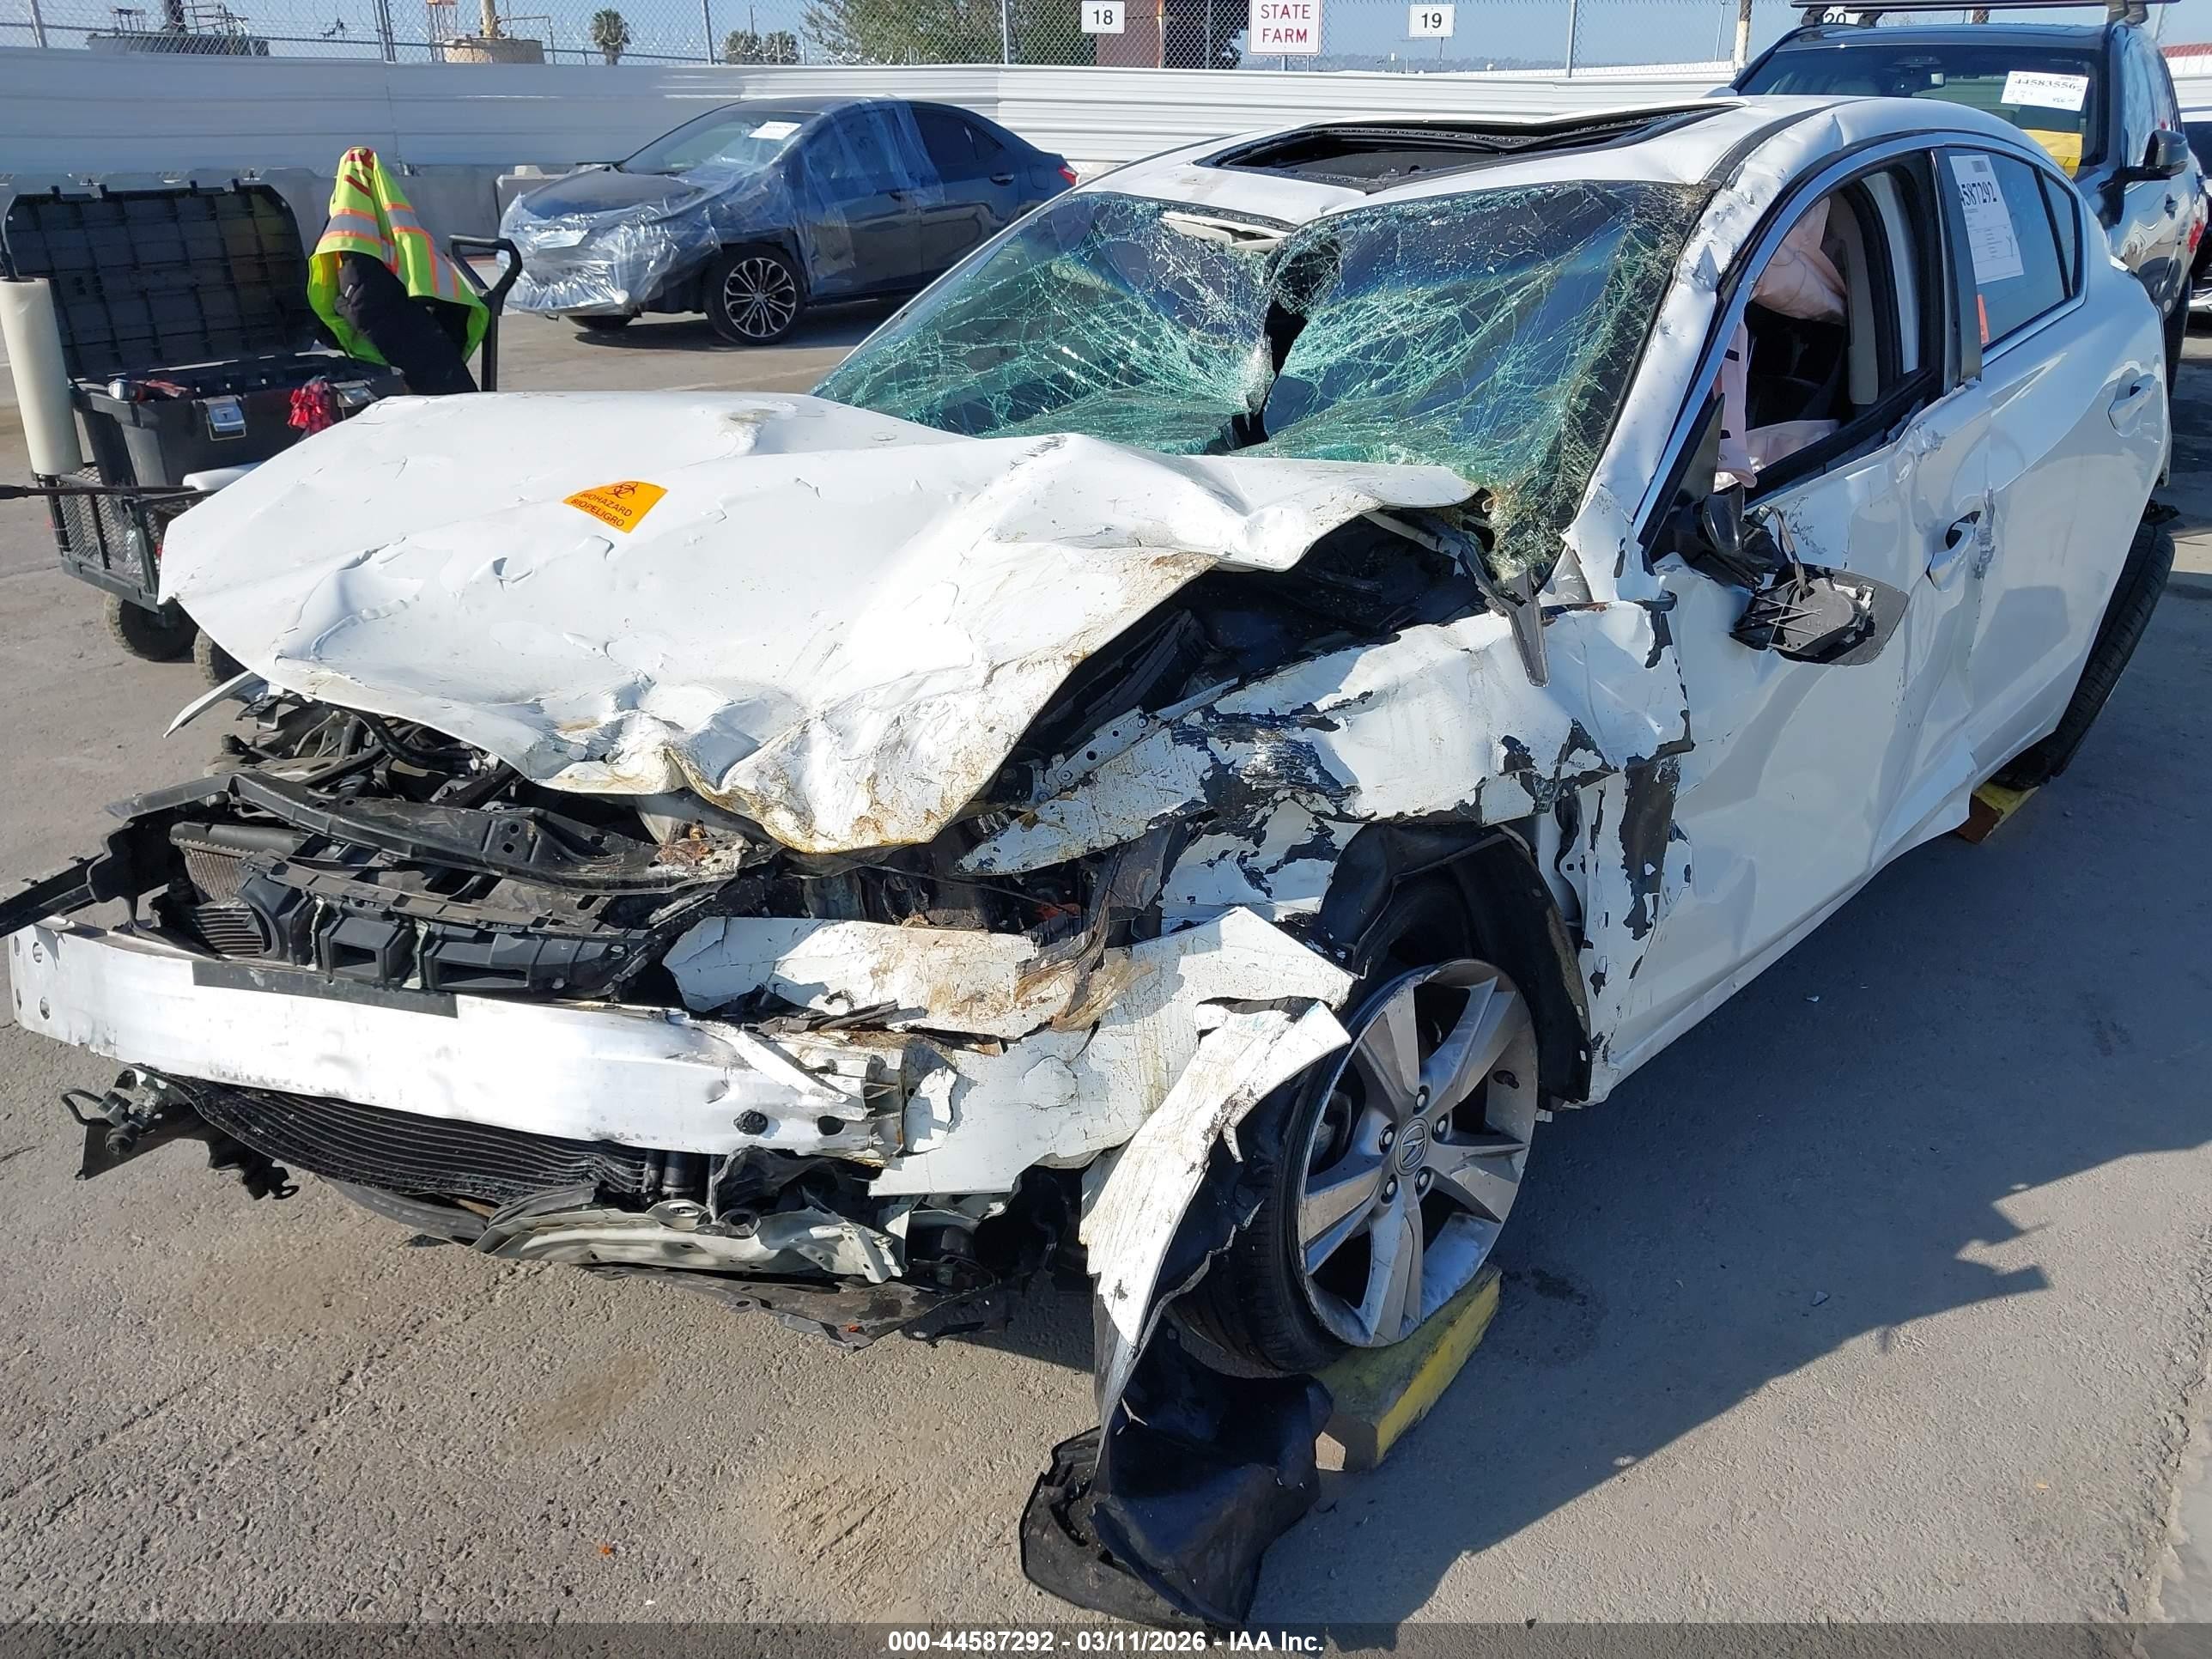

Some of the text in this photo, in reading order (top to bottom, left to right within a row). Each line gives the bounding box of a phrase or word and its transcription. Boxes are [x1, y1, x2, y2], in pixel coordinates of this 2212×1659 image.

[1092, 9, 1113, 25] 18
[1261, 4, 1310, 19] STATE
[1825, 13, 1846, 24] 20
[1421, 13, 1442, 28] 19
[1262, 28, 1307, 43] FARM
[570, 498, 625, 527] BIOPELIGRO
[580, 493, 633, 517] BIOHAZARD
